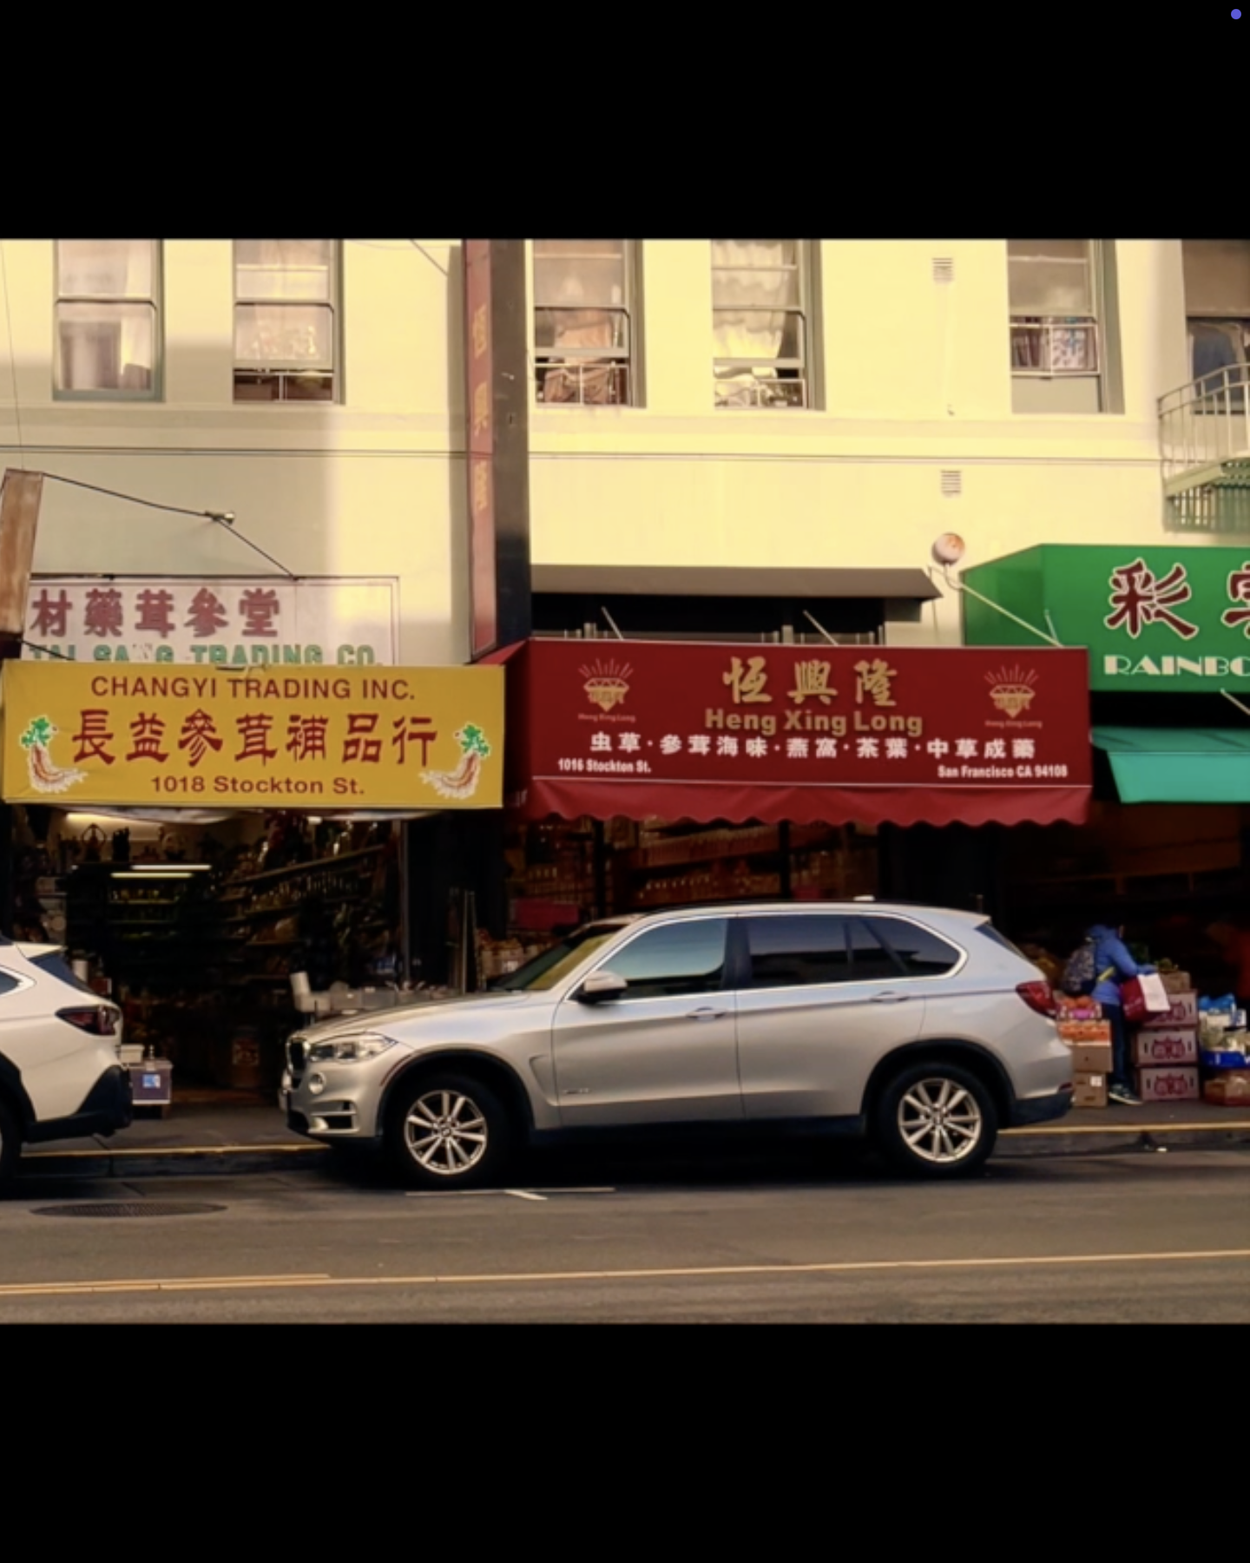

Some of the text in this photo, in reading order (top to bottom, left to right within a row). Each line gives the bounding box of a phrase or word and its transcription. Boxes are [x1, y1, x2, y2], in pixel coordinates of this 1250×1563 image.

[190, 645, 323, 664] TRADING
[91, 676, 416, 700] CHANGYI TRADING INC.
[705, 708, 923, 738] Heng Xing Long
[71, 708, 438, 767] 長益參茸補品行
[558, 758, 652, 773] 1016 Stockton St.
[938, 764, 1068, 778] San Francisco CA 94108
[151, 775, 365, 795] 1018 Stockton St.
